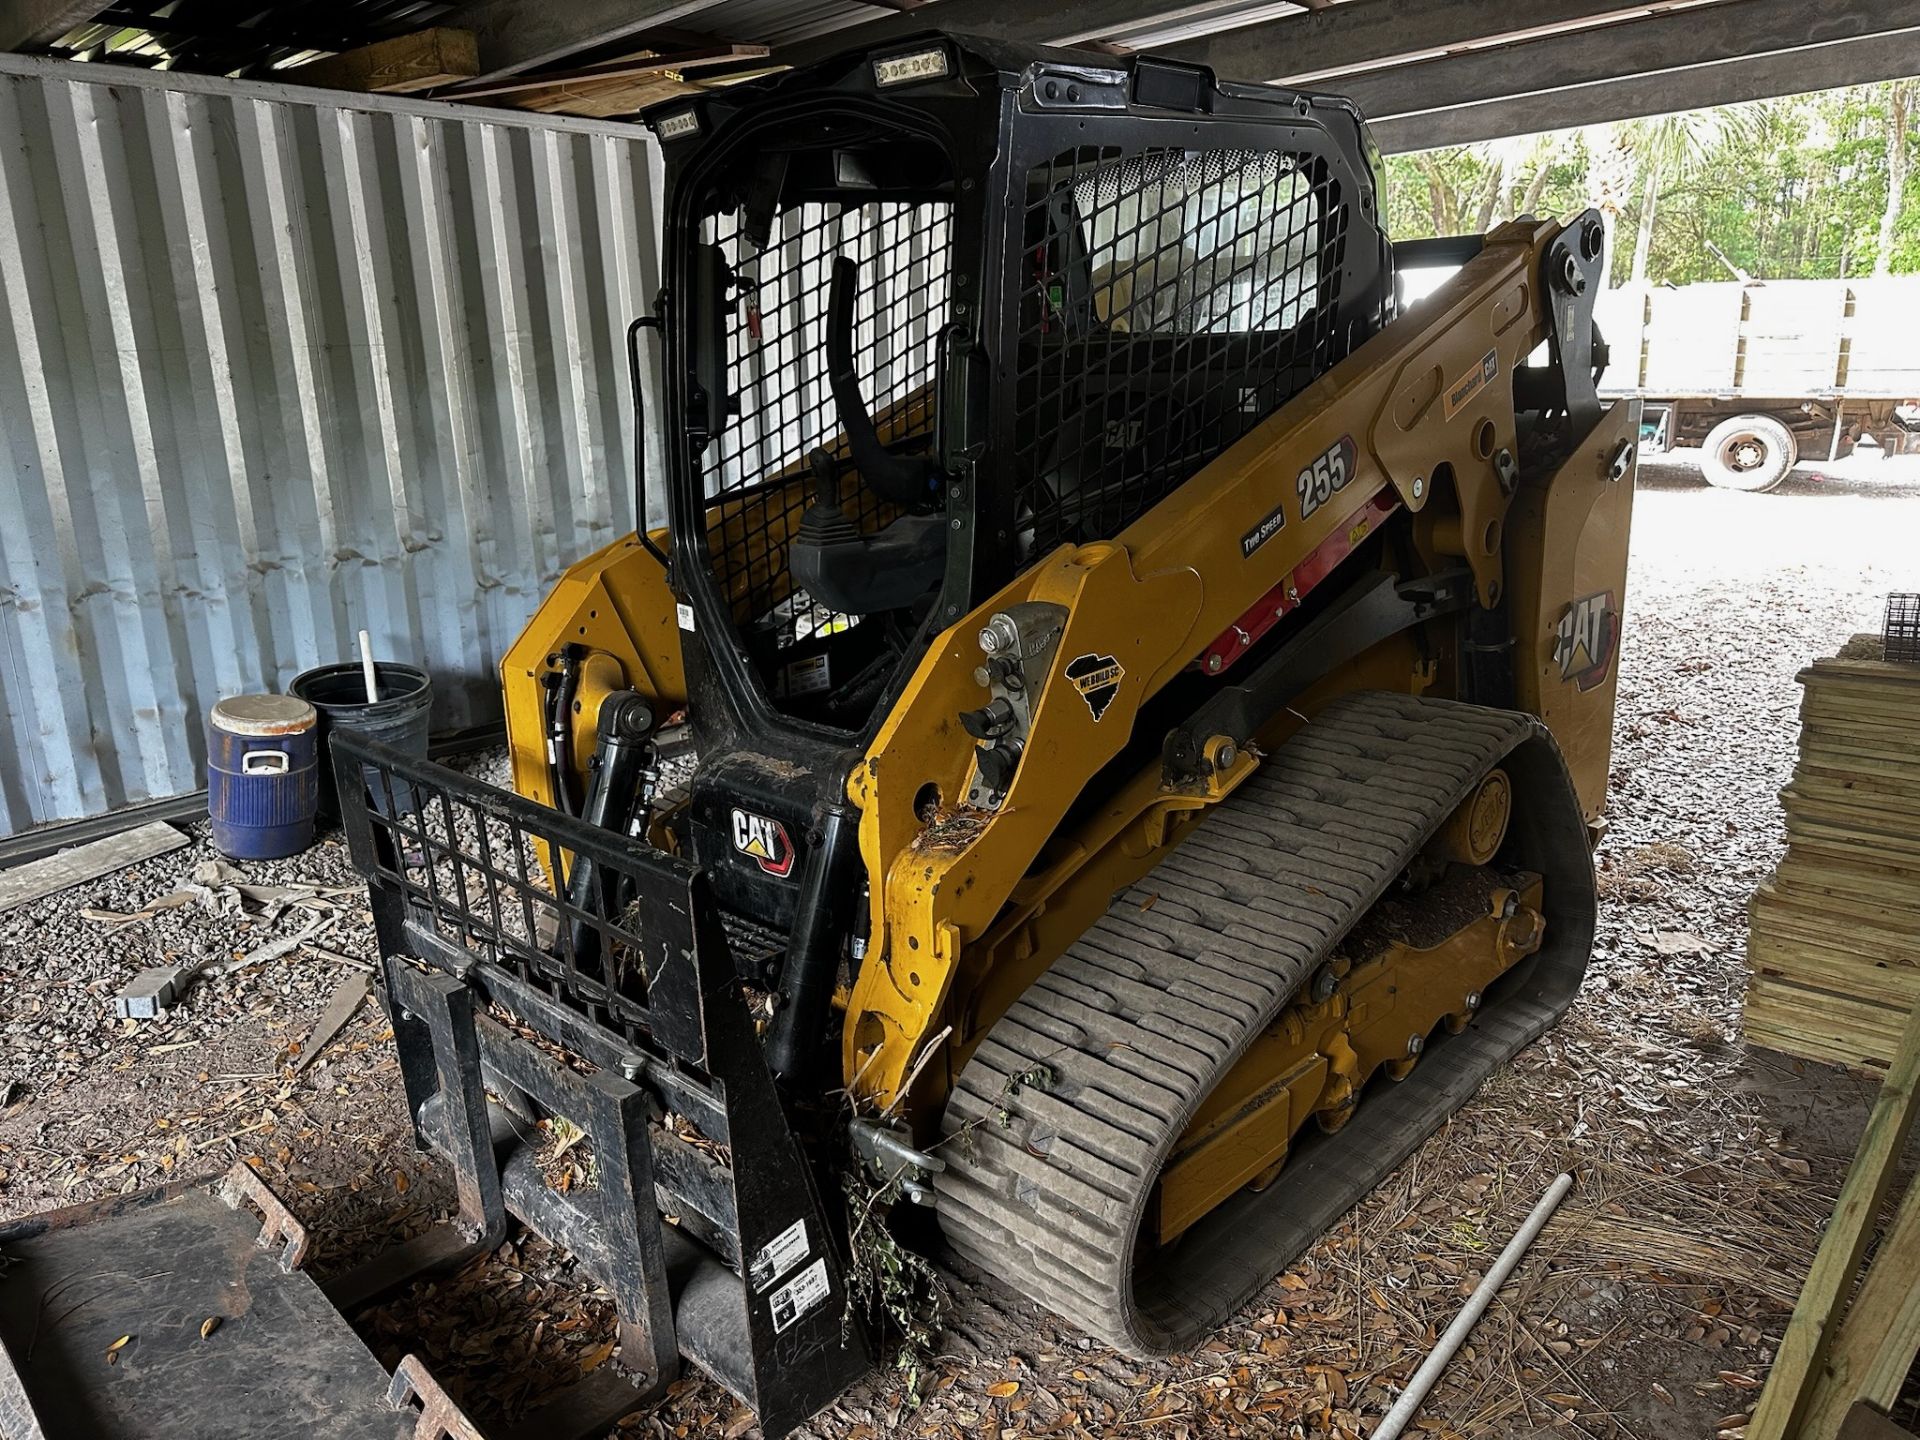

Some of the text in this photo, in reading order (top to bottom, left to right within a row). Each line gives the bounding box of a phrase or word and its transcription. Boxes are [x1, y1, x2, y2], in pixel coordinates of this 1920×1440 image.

[1298, 442, 1346, 518] 255
[1552, 593, 1607, 675] CAT
[732, 810, 776, 861] CAT
